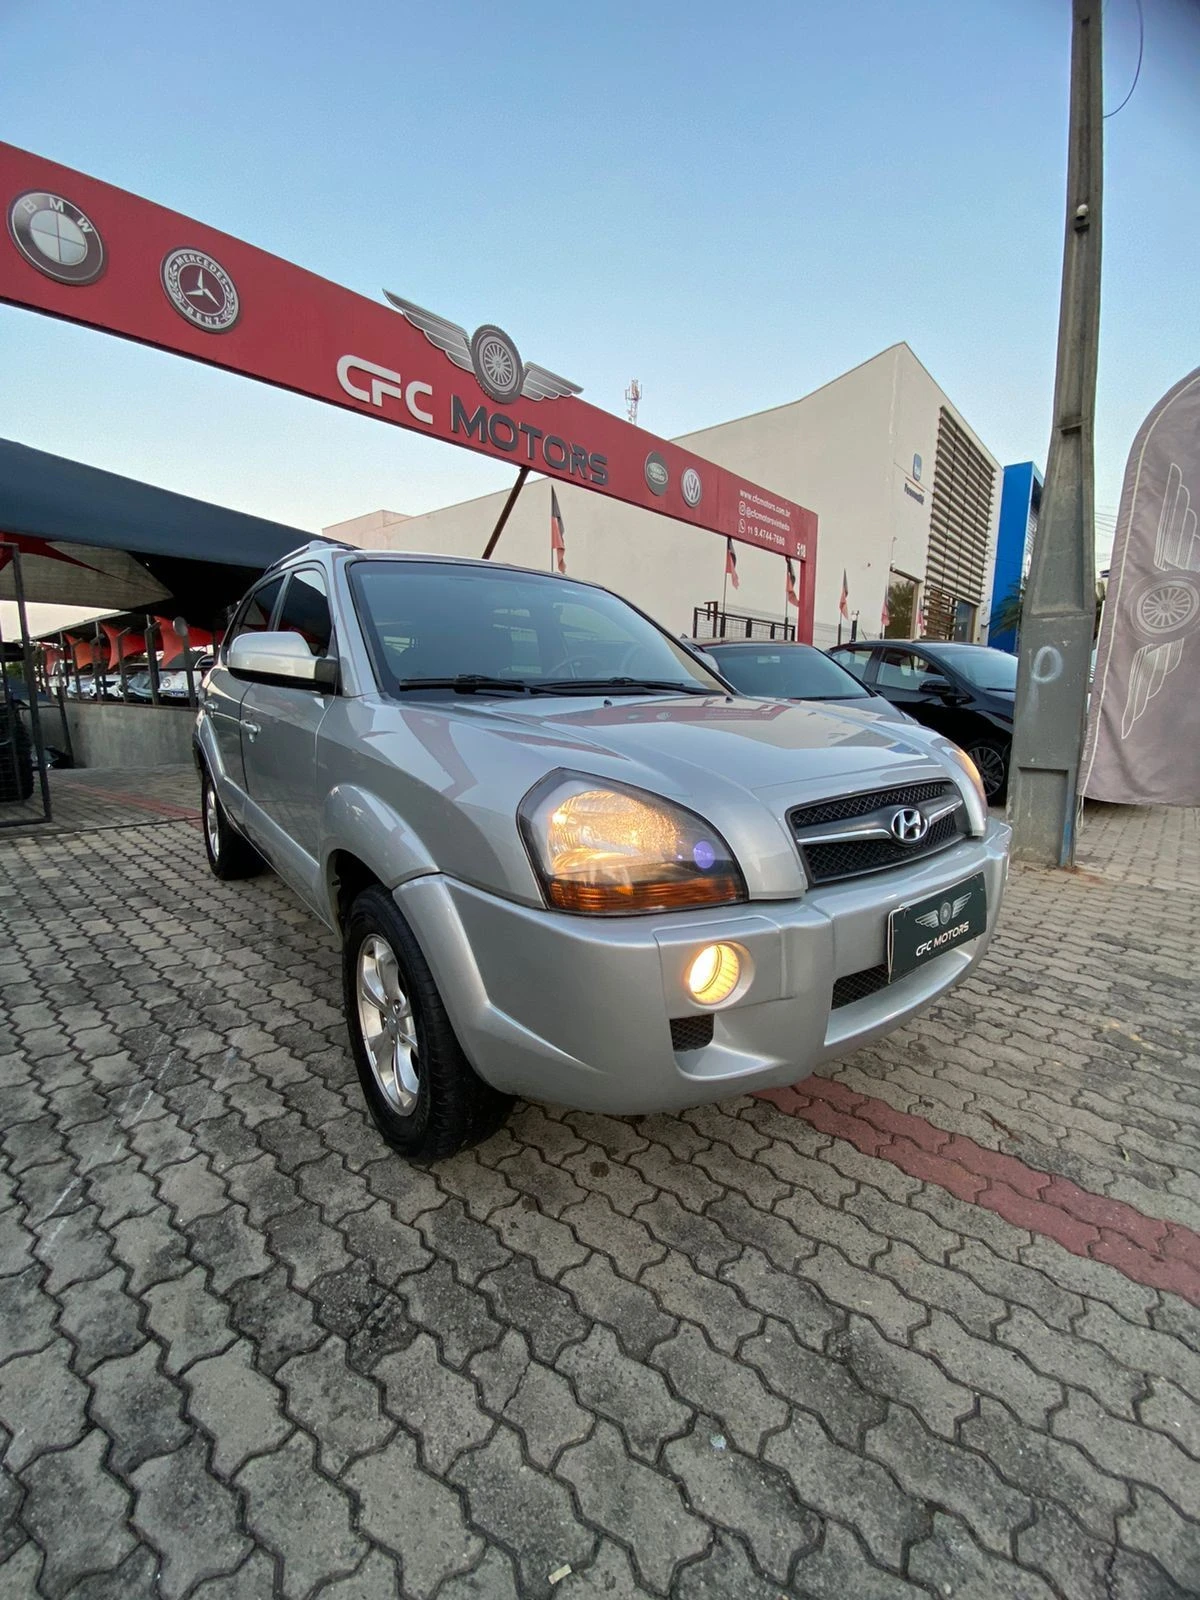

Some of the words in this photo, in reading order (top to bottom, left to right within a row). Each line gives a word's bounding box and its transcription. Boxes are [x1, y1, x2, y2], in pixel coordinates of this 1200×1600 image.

[22, 197, 93, 234] BMW
[175, 254, 228, 285] MERCEDES
[186, 306, 222, 325] BENZ
[336, 354, 433, 425] CFC
[450, 393, 609, 485] MOTORS
[916, 940, 933, 957] CFC
[933, 921, 970, 948] MOTORS
